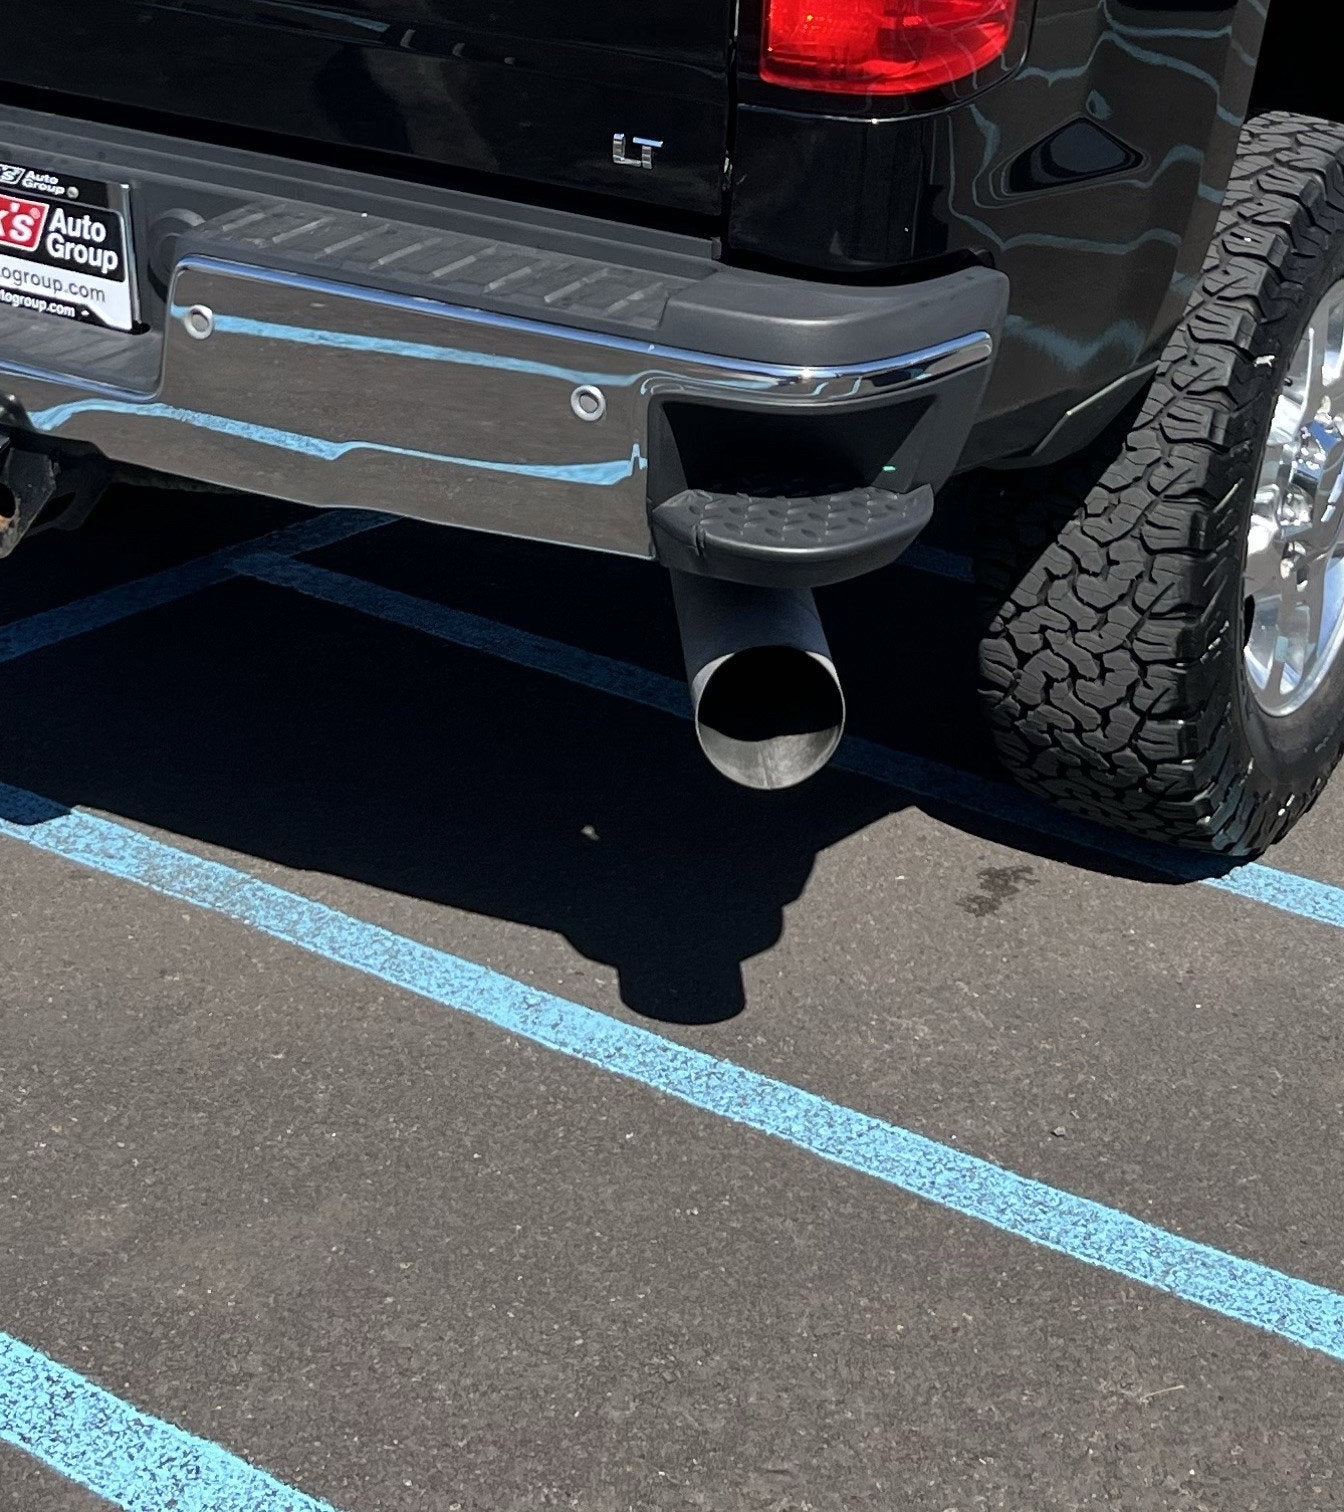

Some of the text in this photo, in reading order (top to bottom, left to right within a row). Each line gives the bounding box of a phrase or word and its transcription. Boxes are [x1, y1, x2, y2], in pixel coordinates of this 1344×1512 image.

[612, 133, 664, 169] LT
[21, 177, 66, 196] Group
[24, 171, 59, 185] Auto
[48, 207, 107, 243] Auto
[45, 232, 119, 275] Group
